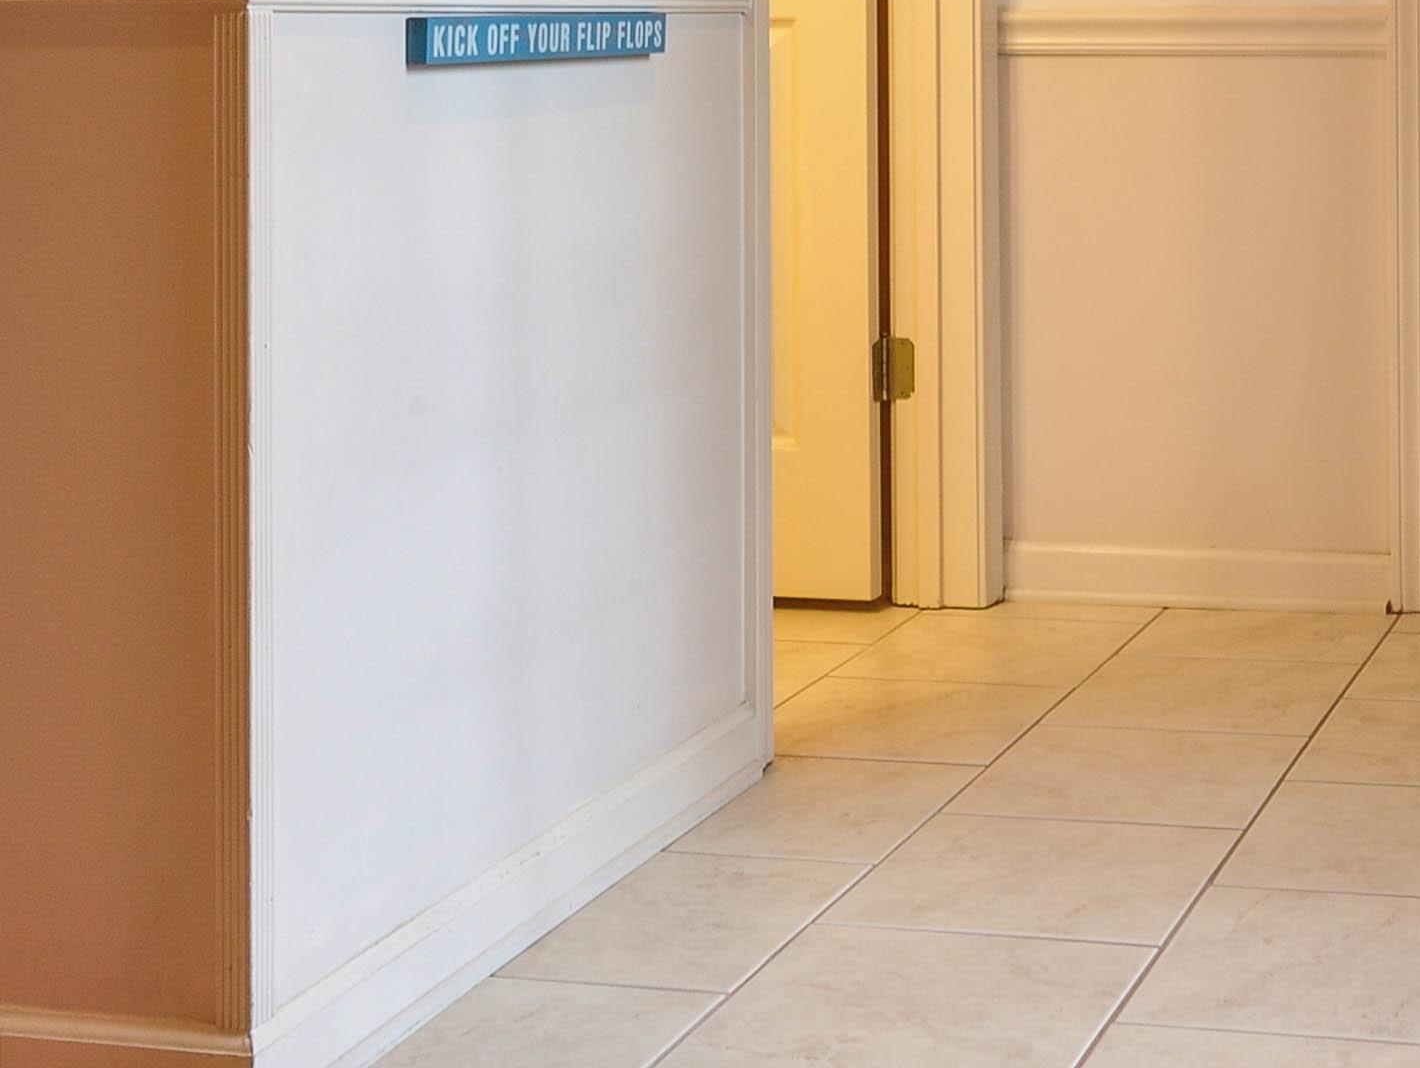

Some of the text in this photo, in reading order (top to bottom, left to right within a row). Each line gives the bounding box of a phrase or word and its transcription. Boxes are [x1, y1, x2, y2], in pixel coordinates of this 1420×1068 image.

[433, 20, 662, 58] KICK OFF YOUR FLIP FLOPS
